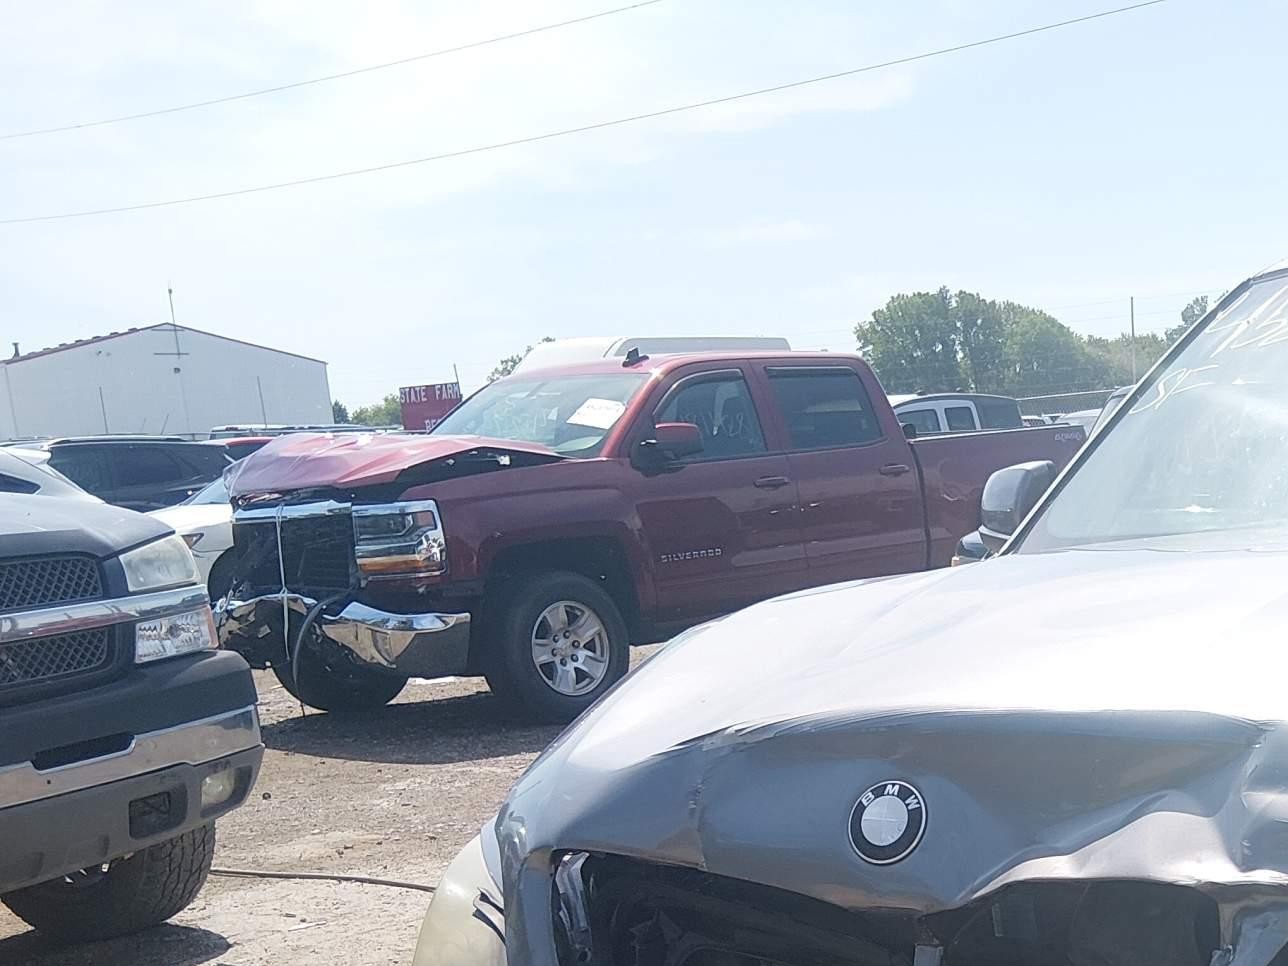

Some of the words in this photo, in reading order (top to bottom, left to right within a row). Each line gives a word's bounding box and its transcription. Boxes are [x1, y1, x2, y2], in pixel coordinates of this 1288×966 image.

[399, 386, 428, 404] STATE
[434, 383, 460, 401] FARM
[660, 548, 722, 563] SILVERADO
[860, 784, 921, 810] BMW
